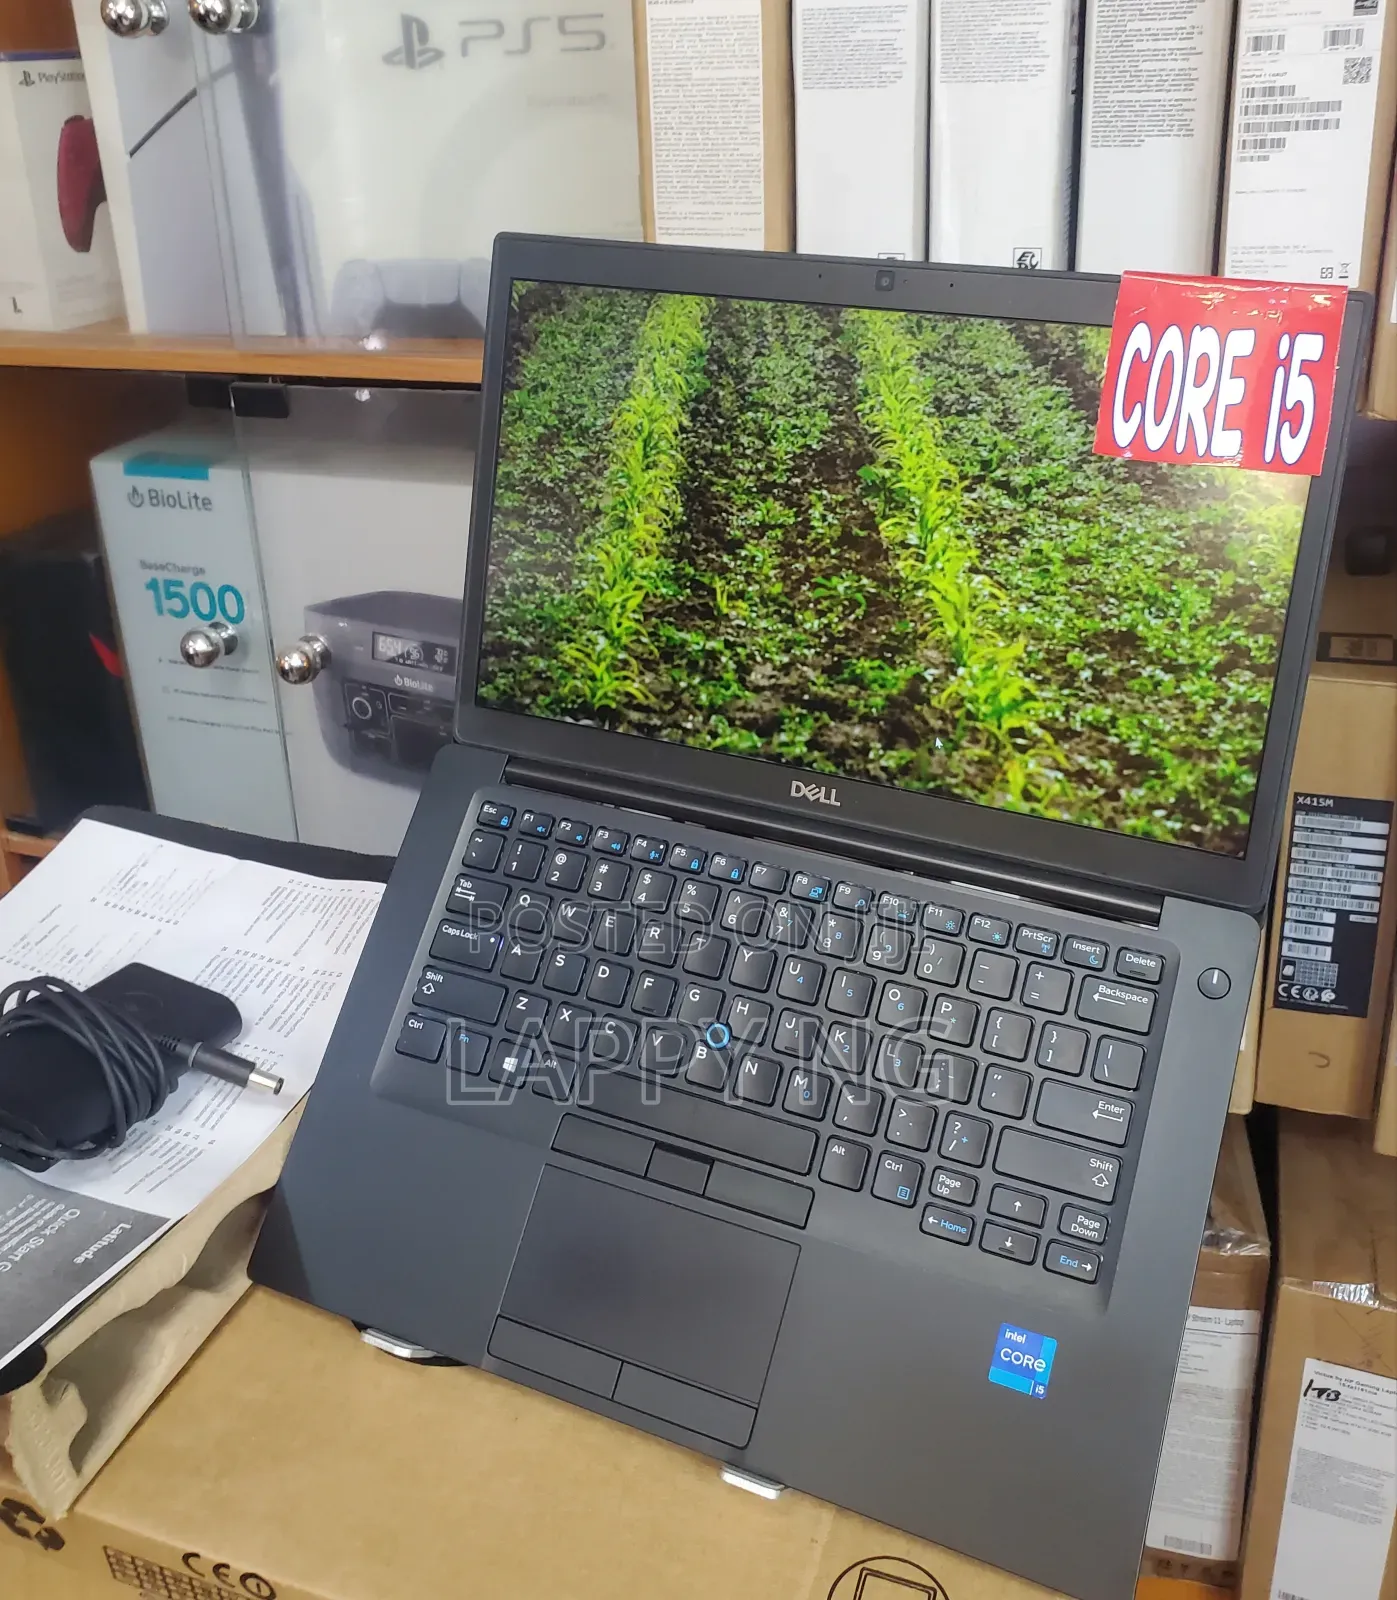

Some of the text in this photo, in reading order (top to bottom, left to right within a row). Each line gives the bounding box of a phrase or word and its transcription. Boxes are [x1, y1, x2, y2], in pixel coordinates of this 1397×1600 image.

[458, 13, 606, 59] PS5
[1112, 320, 1325, 465] CORE i5
[147, 488, 213, 512] BioLite
[140, 559, 206, 576] BaseCharge
[145, 576, 245, 625] 1500
[790, 780, 841, 806] DELL
[483, 805, 498, 815] Esc
[523, 813, 534, 822] F1
[560, 821, 571, 831] F2
[598, 830, 609, 839] F3
[636, 839, 647, 848] F4
[675, 848, 686, 857] F5
[714, 857, 726, 866] F6
[551, 871, 560, 882] 2
[755, 866, 767, 875] F7
[459, 879, 473, 889] Tab
[593, 881, 603, 891] 3
[796, 876, 808, 885] F8
[839, 885, 851, 895] F9
[519, 894, 531, 907] Q
[637, 892, 646, 902] 4
[882, 895, 899, 906] F10
[561, 903, 577, 917] W
[682, 903, 692, 913] 5
[928, 906, 943, 917] F11
[605, 915, 617, 928] E
[727, 914, 737, 924] 6
[974, 918, 992, 929] F12
[442, 925, 478, 940] Caps Lock
[649, 927, 661, 939] R
[775, 925, 784, 936] 7
[1021, 929, 1054, 943] PrtScr
[696, 938, 707, 950] T
[822, 938, 831, 948] 8
[1072, 941, 1100, 954] Insert
[511, 944, 522, 956] A
[743, 950, 754, 962] Y
[872, 950, 882, 961] 9
[555, 954, 566, 967] S
[1125, 953, 1156, 968] Delete
[598, 966, 610, 978] D
[789, 962, 801, 974] U
[425, 971, 444, 983] Shift
[643, 977, 655, 989] F
[689, 989, 700, 1002] G
[888, 988, 901, 1001] O
[1098, 984, 1149, 1005] Backspace
[516, 996, 529, 1010] Z
[736, 1002, 749, 1015] H
[940, 1002, 952, 1014] P
[559, 1008, 572, 1022] X
[408, 1019, 424, 1030] Ctrl
[604, 1021, 616, 1034] C
[785, 1017, 796, 1029] J
[459, 1033, 469, 1043] Fn
[652, 1034, 663, 1046] V
[834, 1029, 847, 1043] K
[696, 1046, 707, 1059] B
[886, 1043, 896, 1057] L
[543, 1059, 557, 1069] Alt
[745, 1061, 758, 1075] N
[793, 1075, 809, 1089] M
[1097, 1100, 1125, 1114] Enter
[831, 1144, 846, 1156] Alt
[884, 1159, 903, 1172] Ctrl
[1089, 1157, 1114, 1172] Shift
[938, 1174, 961, 1189] Page
[937, 1184, 950, 1196] Up
[39, 1208, 81, 1236] Quick
[940, 1218, 967, 1235] Home
[1077, 1214, 1101, 1230] Page
[1070, 1223, 1099, 1239] Down
[8, 1236, 45, 1261] Start
[73, 1222, 133, 1264] Latitude
[1059, 1255, 1078, 1268] End
[1004, 1328, 1027, 1345] intel
[1035, 1384, 1046, 1395] i5
